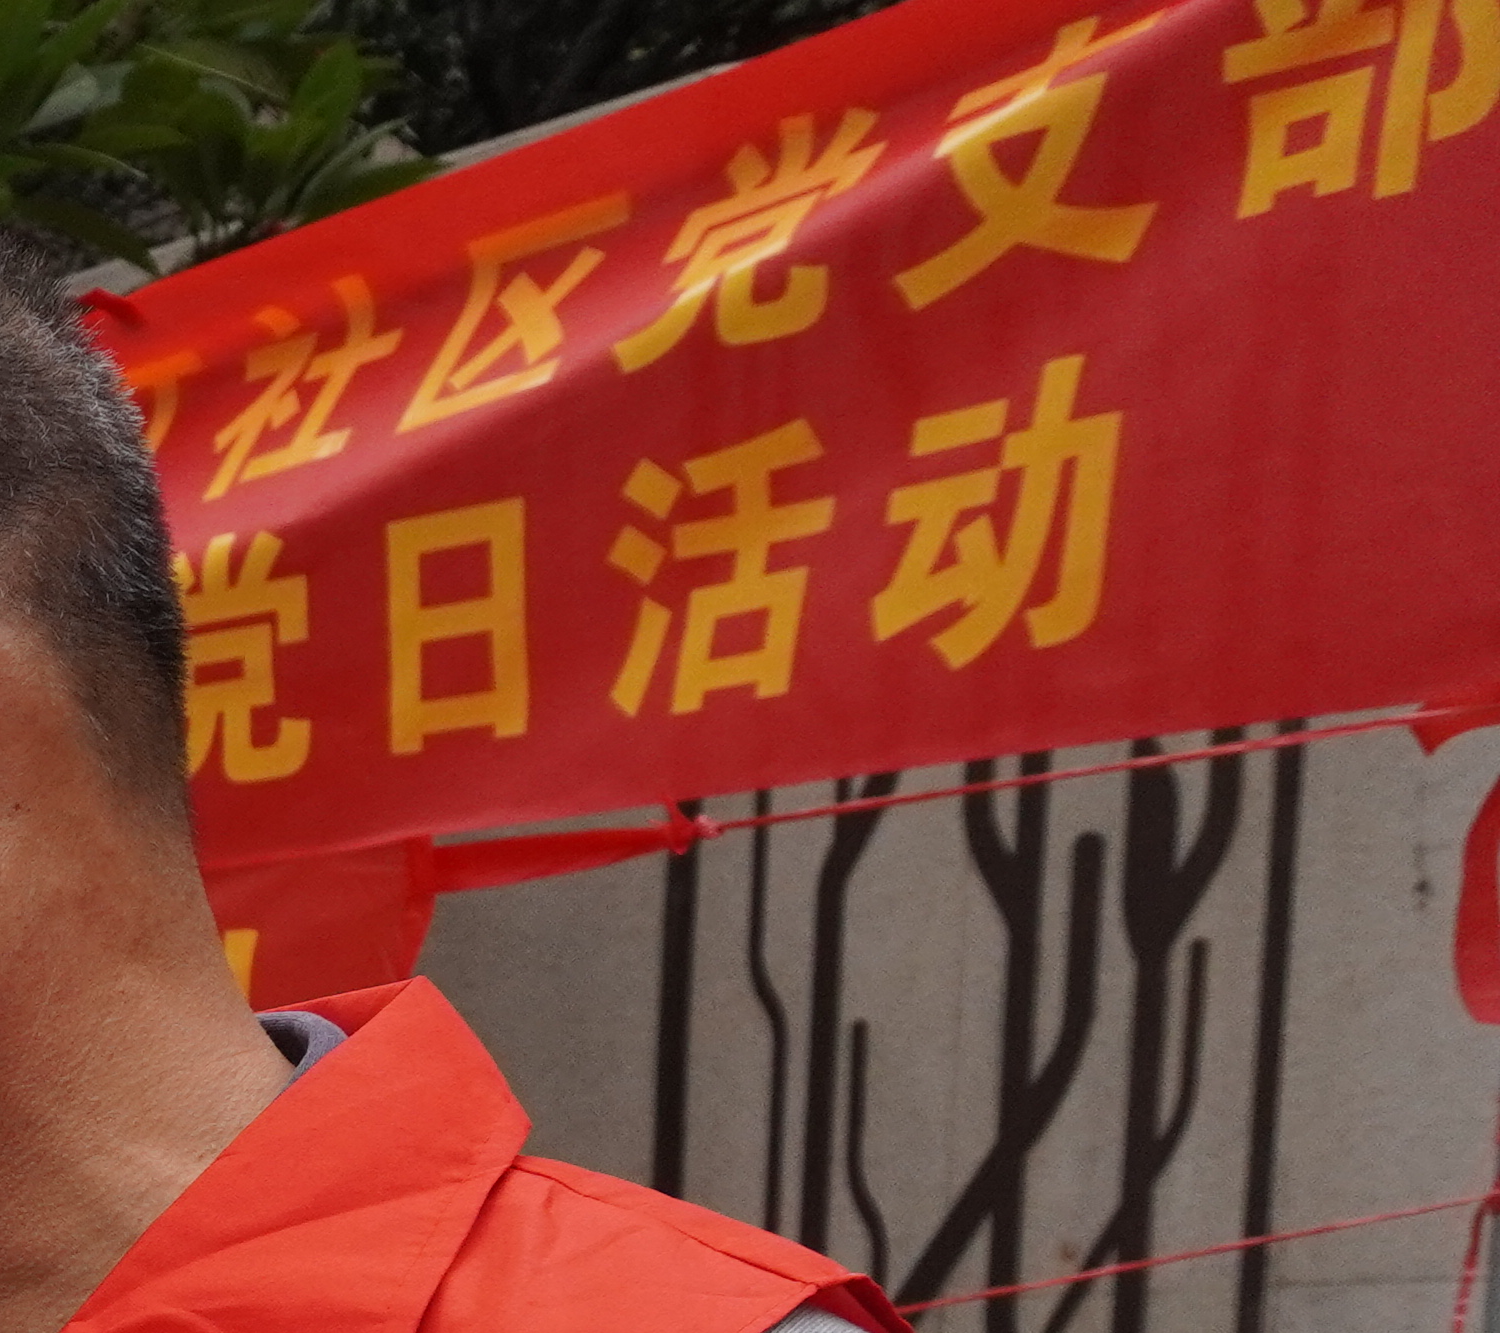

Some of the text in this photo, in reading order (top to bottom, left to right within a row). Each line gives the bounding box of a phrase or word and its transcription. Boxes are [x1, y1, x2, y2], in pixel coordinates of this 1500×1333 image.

[118, 0, 1500, 503] 社区党支部
[173, 355, 1122, 787] 党日活动
